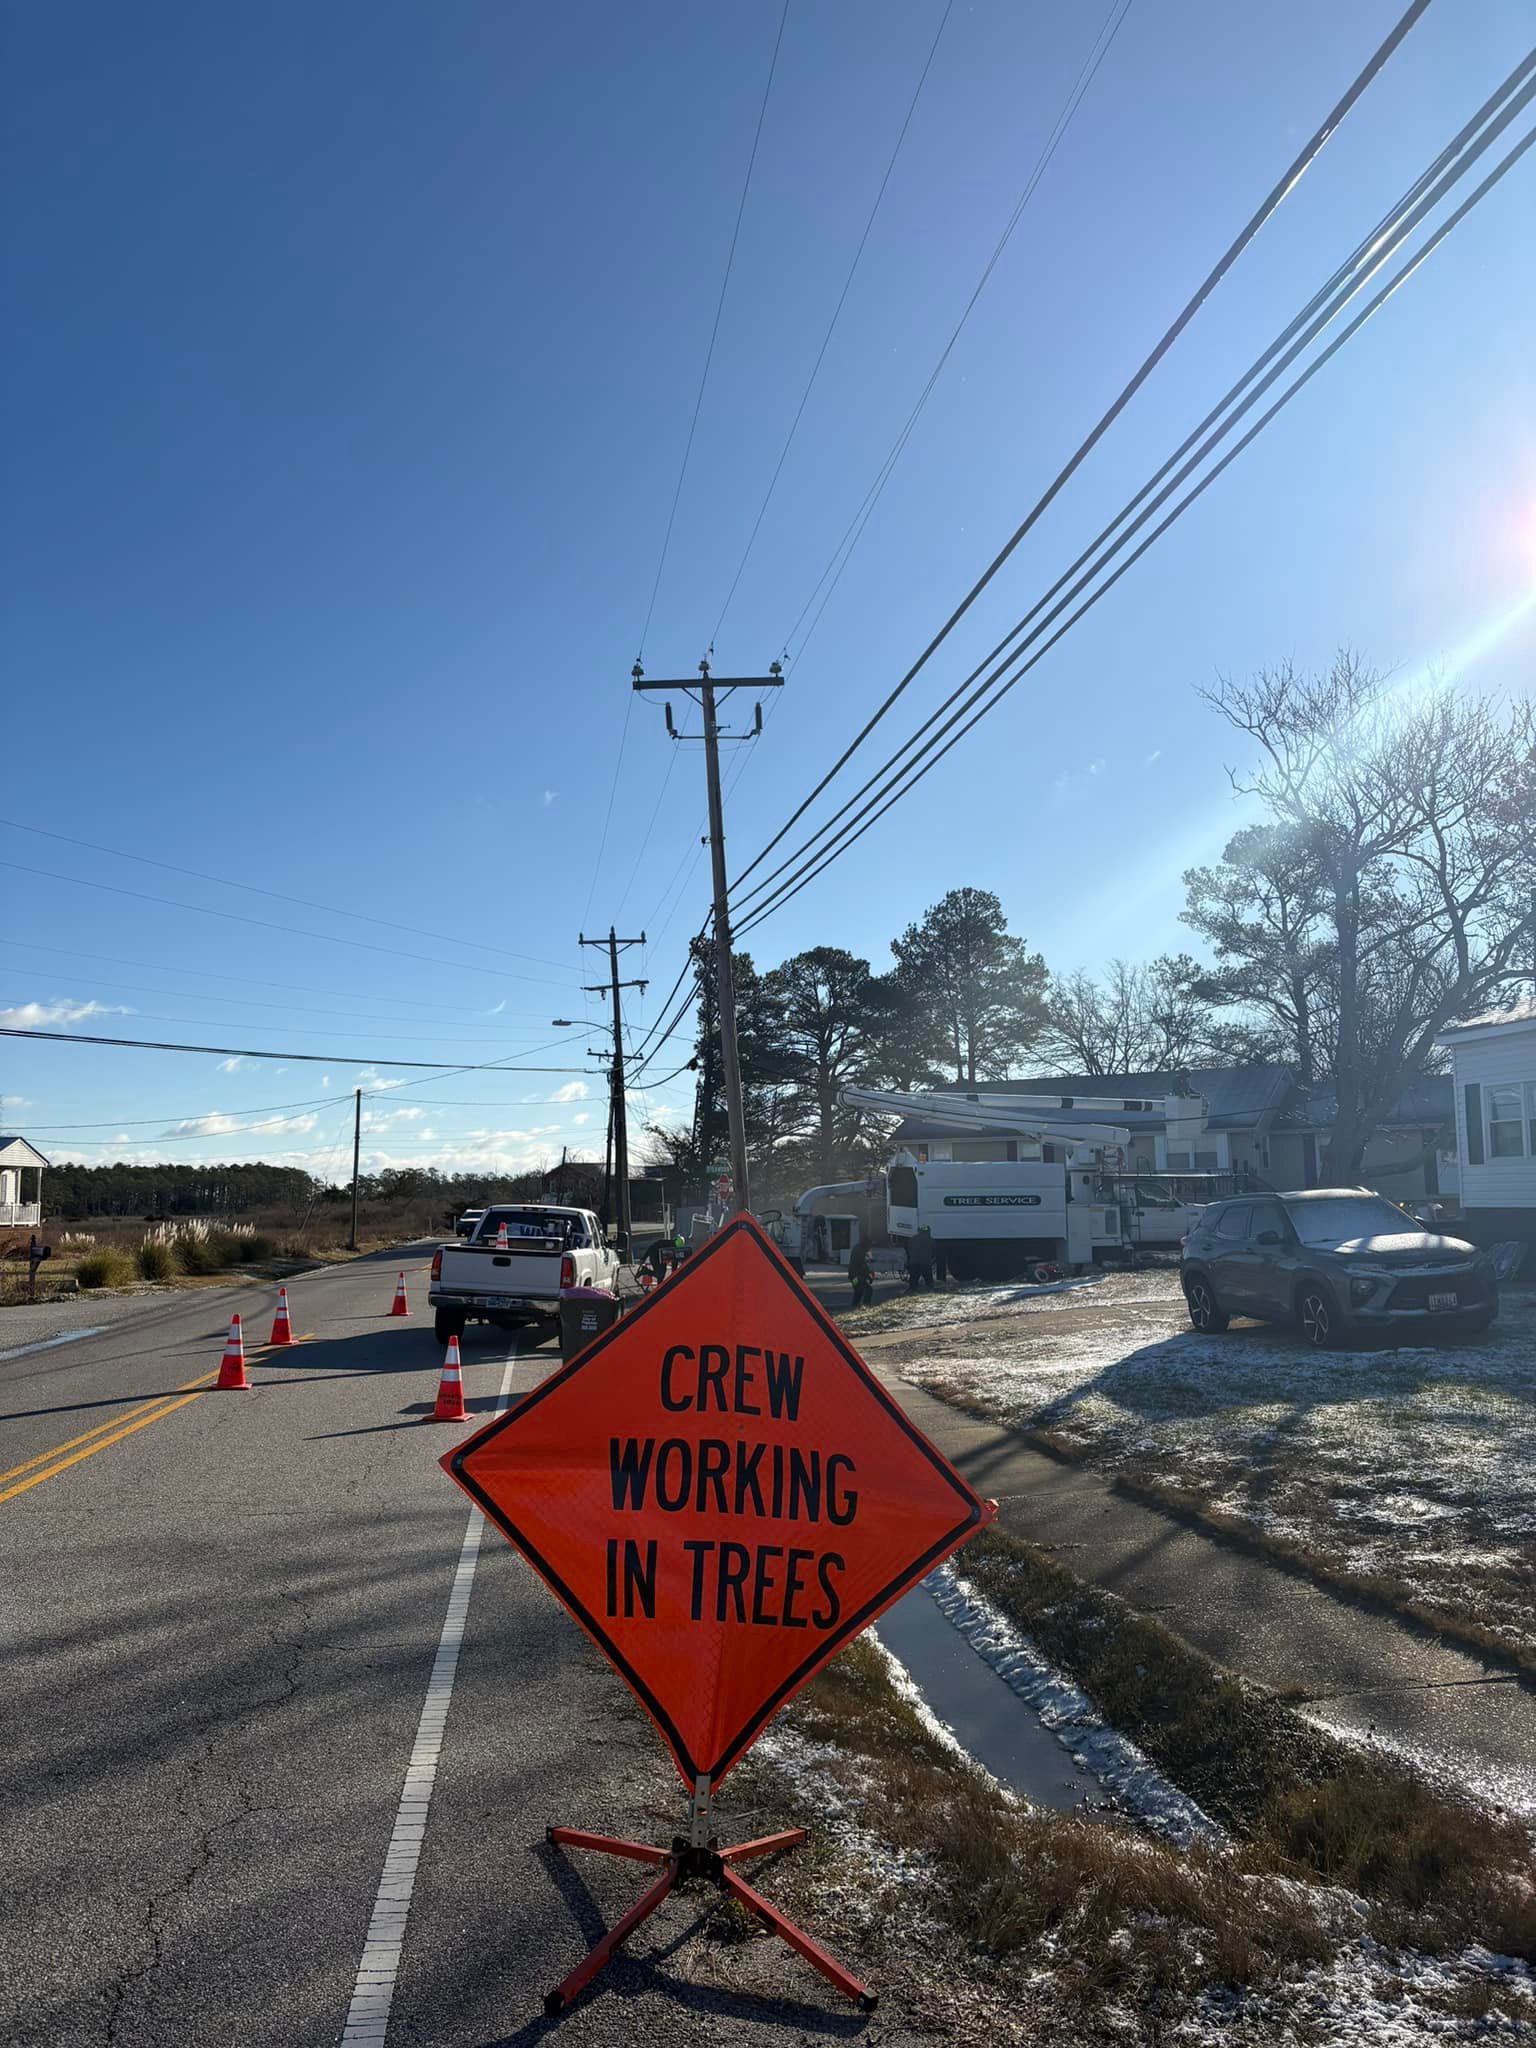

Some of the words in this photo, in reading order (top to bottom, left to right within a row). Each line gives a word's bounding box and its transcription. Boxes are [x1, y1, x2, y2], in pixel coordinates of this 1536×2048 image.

[950, 1197, 981, 1205] TREE
[985, 1197, 1037, 1205] SERVICE
[660, 1344, 805, 1422] CREW
[609, 1437, 859, 1527] WORKING
[606, 1538, 658, 1619] IN
[683, 1540, 846, 1630] TREES
